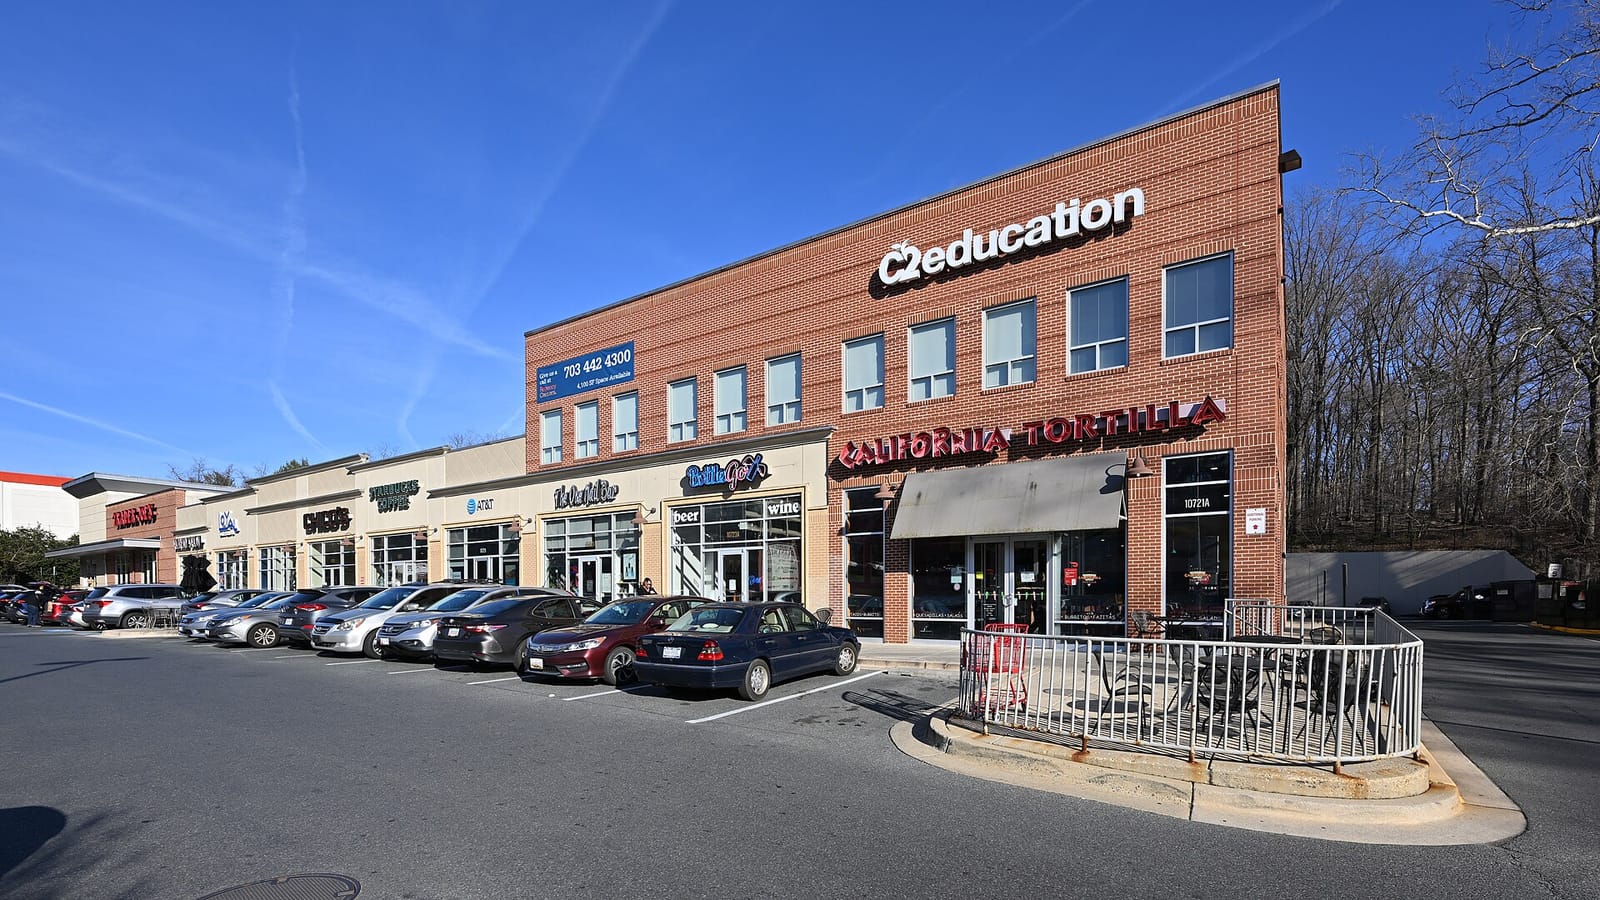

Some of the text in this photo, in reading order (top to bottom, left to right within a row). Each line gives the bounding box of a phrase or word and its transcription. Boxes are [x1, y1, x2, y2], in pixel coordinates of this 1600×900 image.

[563, 349, 631, 379] 703 442 4300
[594, 376, 608, 385] Space
[609, 370, 631, 381] Available
[839, 395, 1226, 469] CALIFORNIA TORTILLA
[369, 480, 419, 500] STARBUCKS
[554, 485, 567, 510] The
[600, 479, 619, 503] Bar
[378, 495, 410, 512] COFFEE
[477, 499, 494, 510] AT&T
[768, 501, 799, 516] wine
[1184, 498, 1210, 509] 10721A
[673, 510, 699, 523] beer
